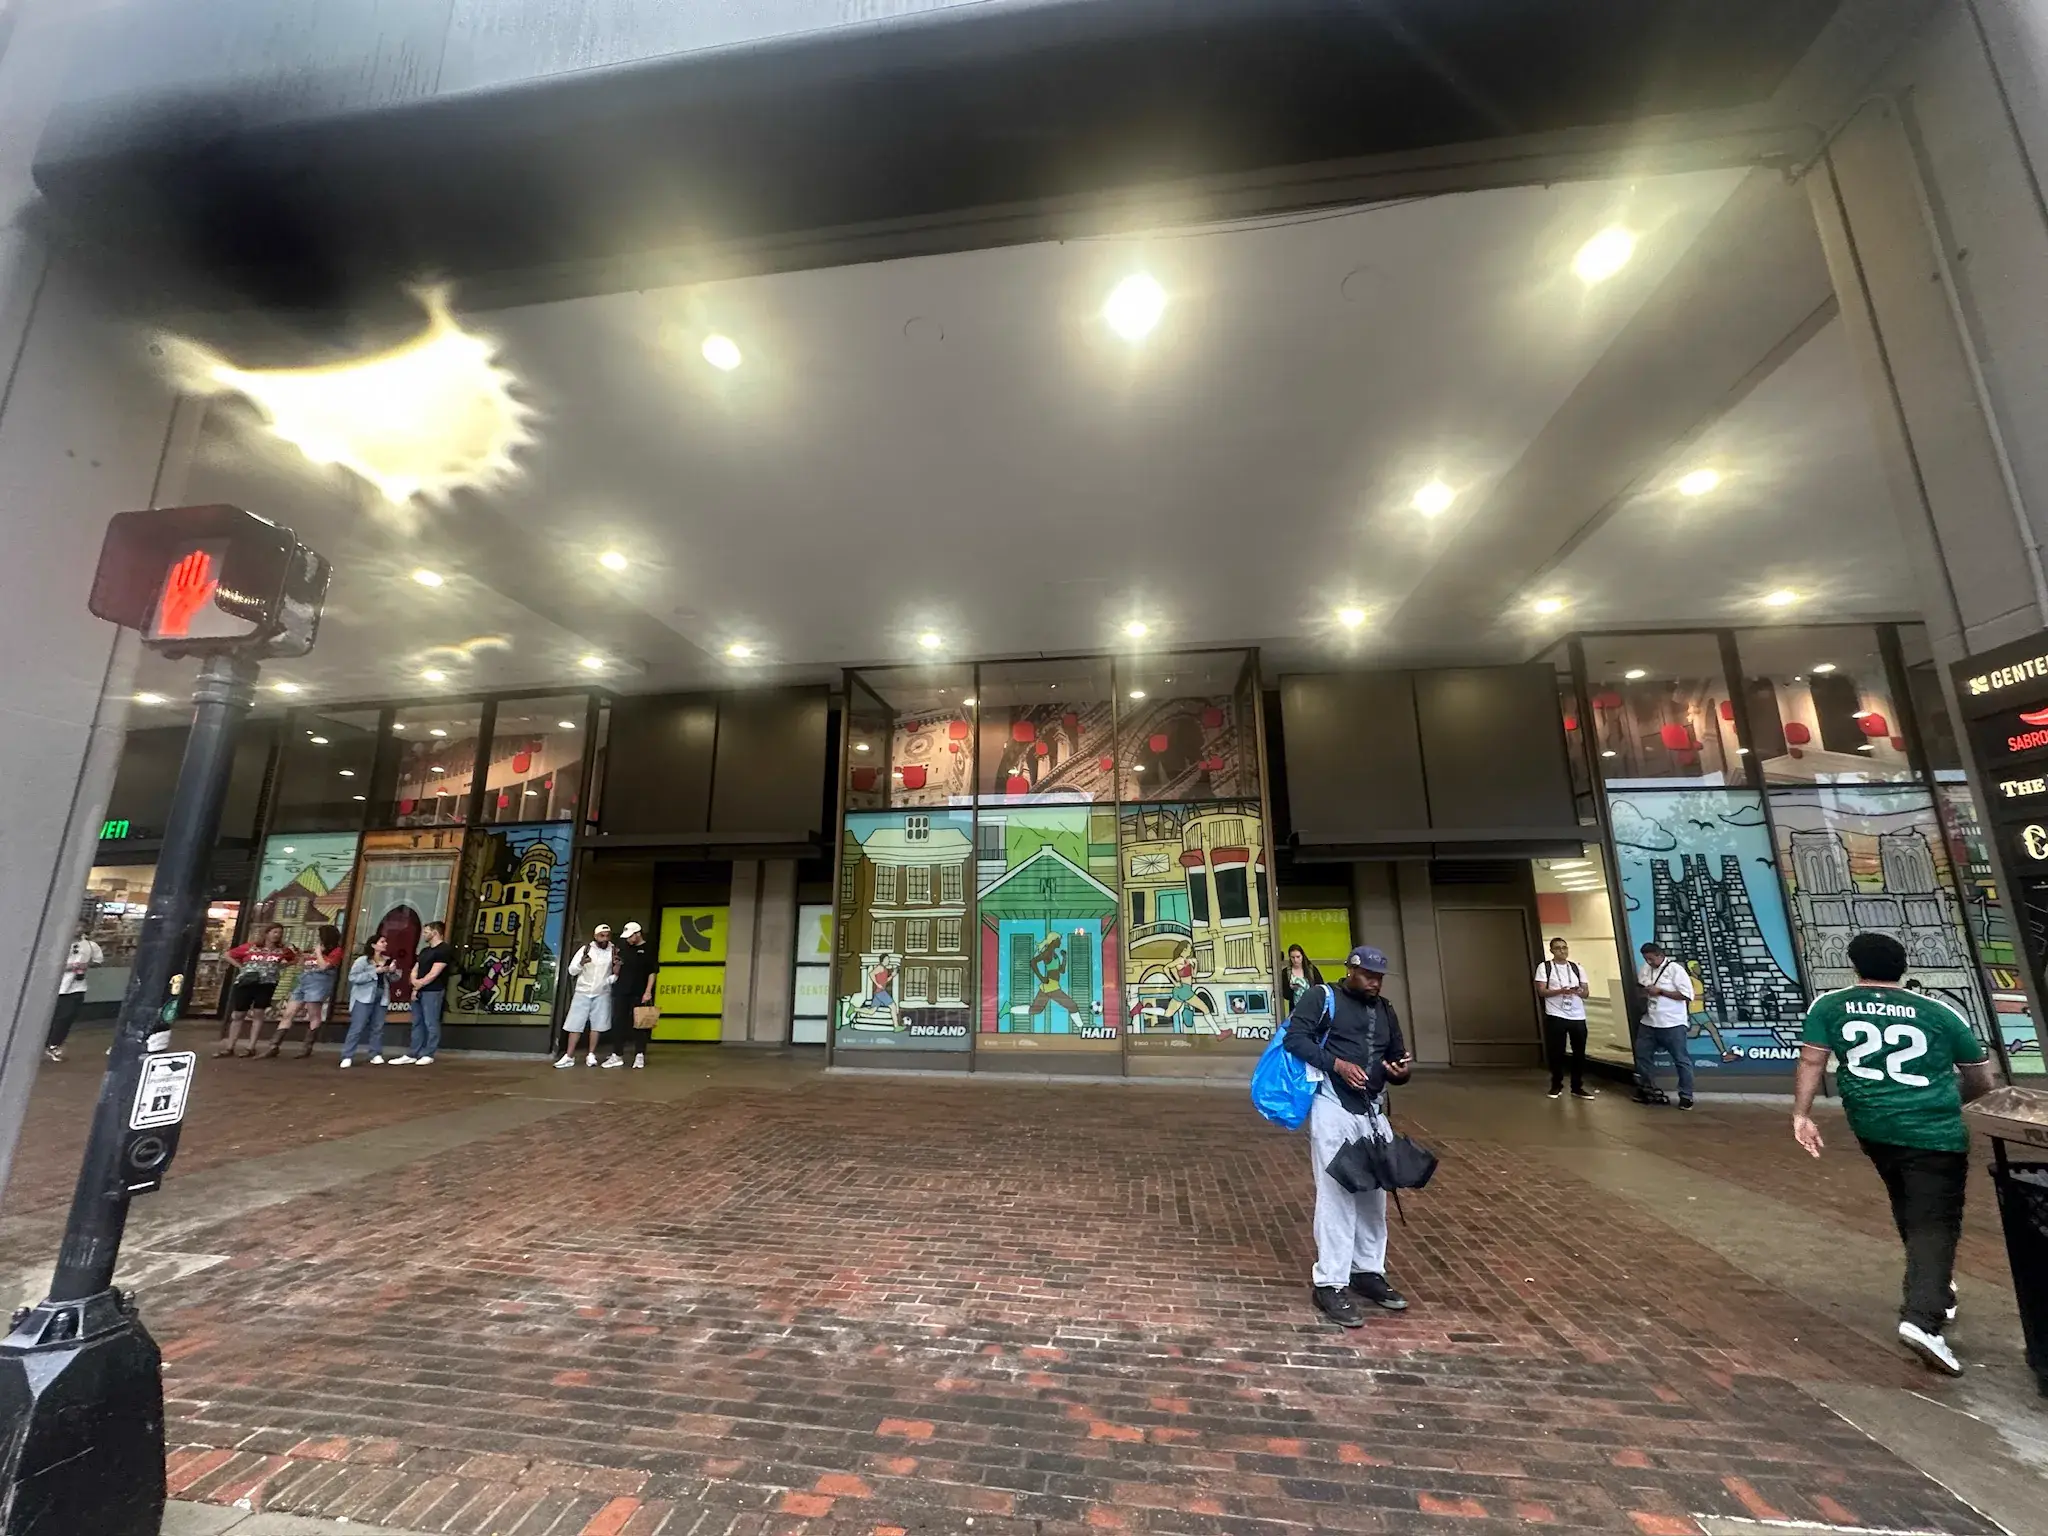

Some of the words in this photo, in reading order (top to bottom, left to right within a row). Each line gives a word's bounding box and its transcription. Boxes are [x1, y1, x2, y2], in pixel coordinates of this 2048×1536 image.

[1991, 655, 2048, 689] CENTE
[2008, 730, 2048, 752] SABRO
[2000, 778, 2046, 798] THE
[660, 984, 693, 995] CENTER
[695, 984, 722, 995] PLAZA
[494, 1002, 540, 1013] SCOTLAND
[910, 1025, 967, 1037] ENGLAND
[1081, 1027, 1117, 1039] HAITI
[1236, 1027, 1271, 1040] IRAQ
[1749, 1047, 1800, 1060] GHANA
[1842, 1020, 1930, 1087] 22
